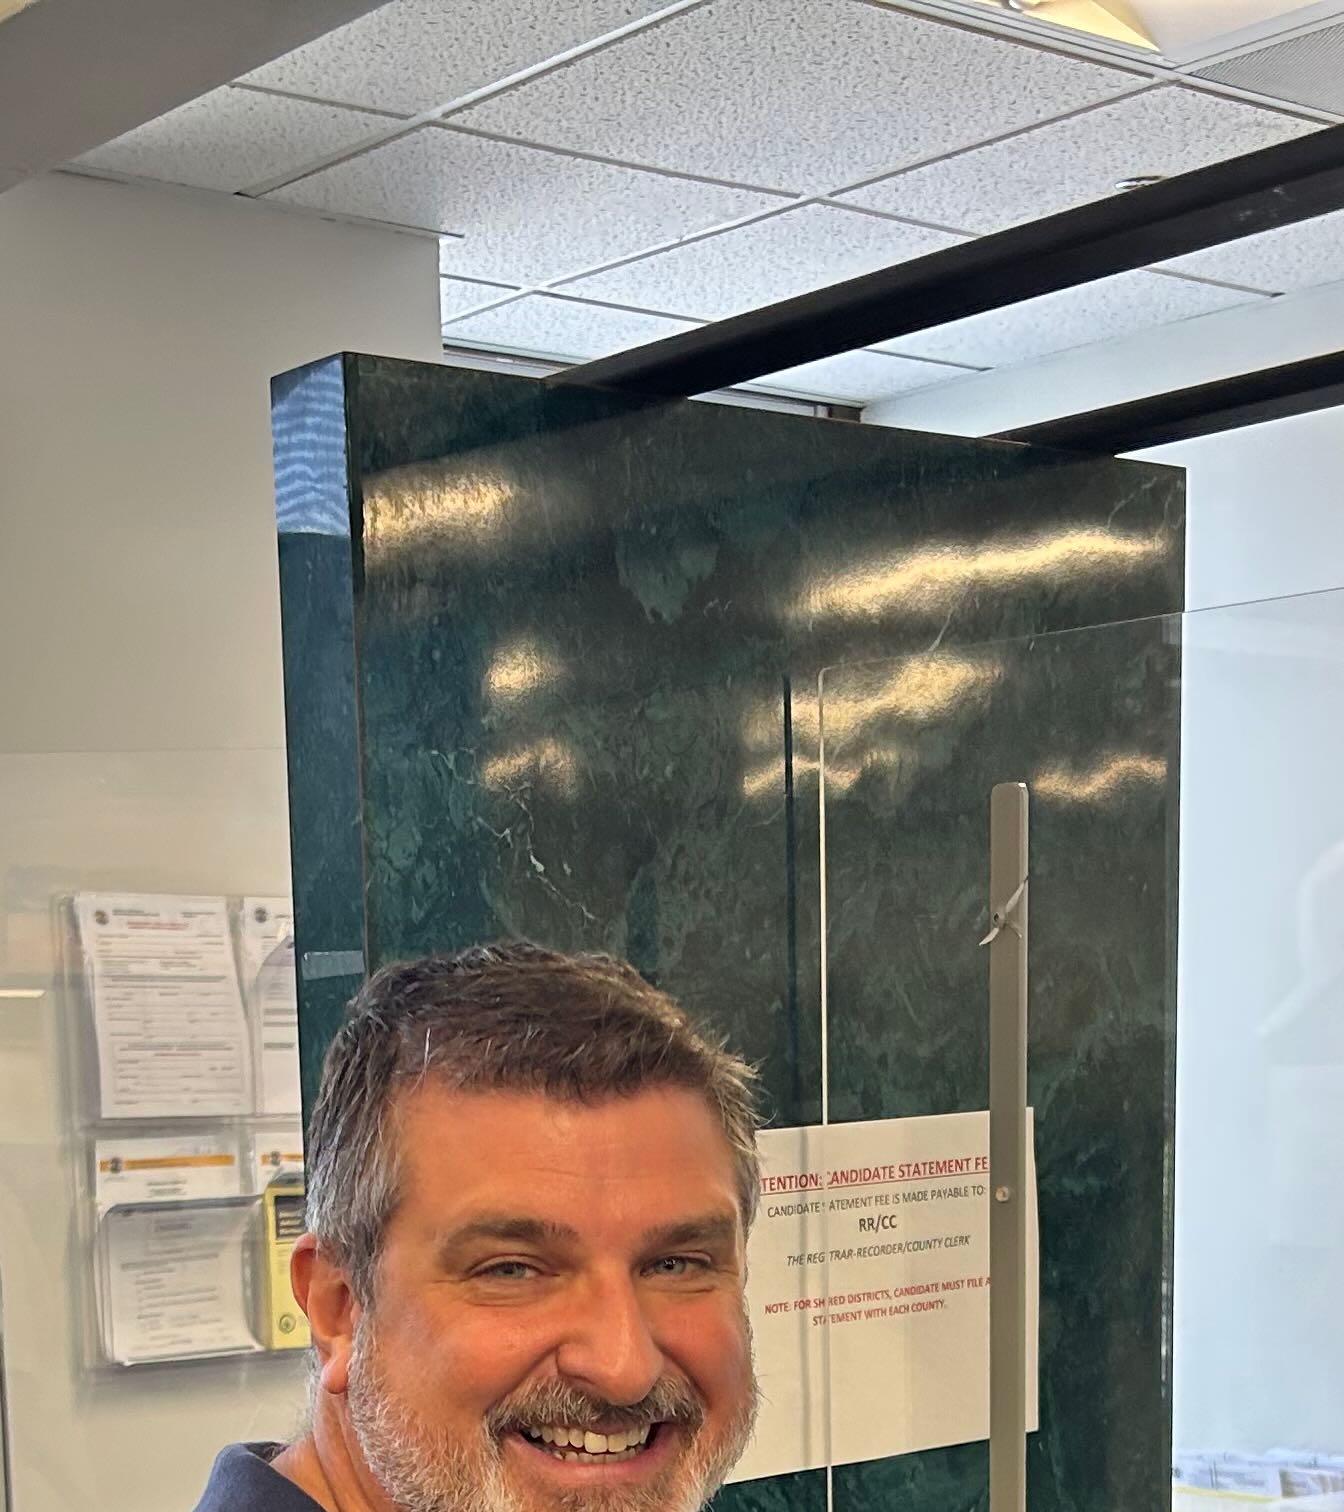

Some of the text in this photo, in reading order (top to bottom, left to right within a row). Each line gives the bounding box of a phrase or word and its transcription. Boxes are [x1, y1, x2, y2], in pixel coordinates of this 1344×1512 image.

[759, 1173, 822, 1192] TENTION:
[898, 1158, 972, 1178] STATEMENT
[974, 1156, 989, 1170] FE
[767, 1202, 820, 1218] CANDIDATE
[822, 1196, 873, 1211] ATEMENT
[874, 1194, 890, 1206] FEE
[892, 1193, 900, 1204] IS
[902, 1190, 928, 1203] MADE
[931, 1186, 969, 1200] PAYABLE
[858, 1214, 898, 1234] RR/CC
[786, 1235, 971, 1266] THE REGTRAR-RECORDER/COUNTY CLERK
[793, 1299, 811, 1311] FOR
[813, 1295, 845, 1308] SHRED
[847, 1289, 892, 1304] DISTRICTS,
[894, 1282, 939, 1298] CANDIDATE
[942, 1279, 965, 1291] MUST
[967, 1277, 983, 1288] FILE
[864, 1306, 887, 1320] WITH
[889, 1303, 910, 1316] EACH
